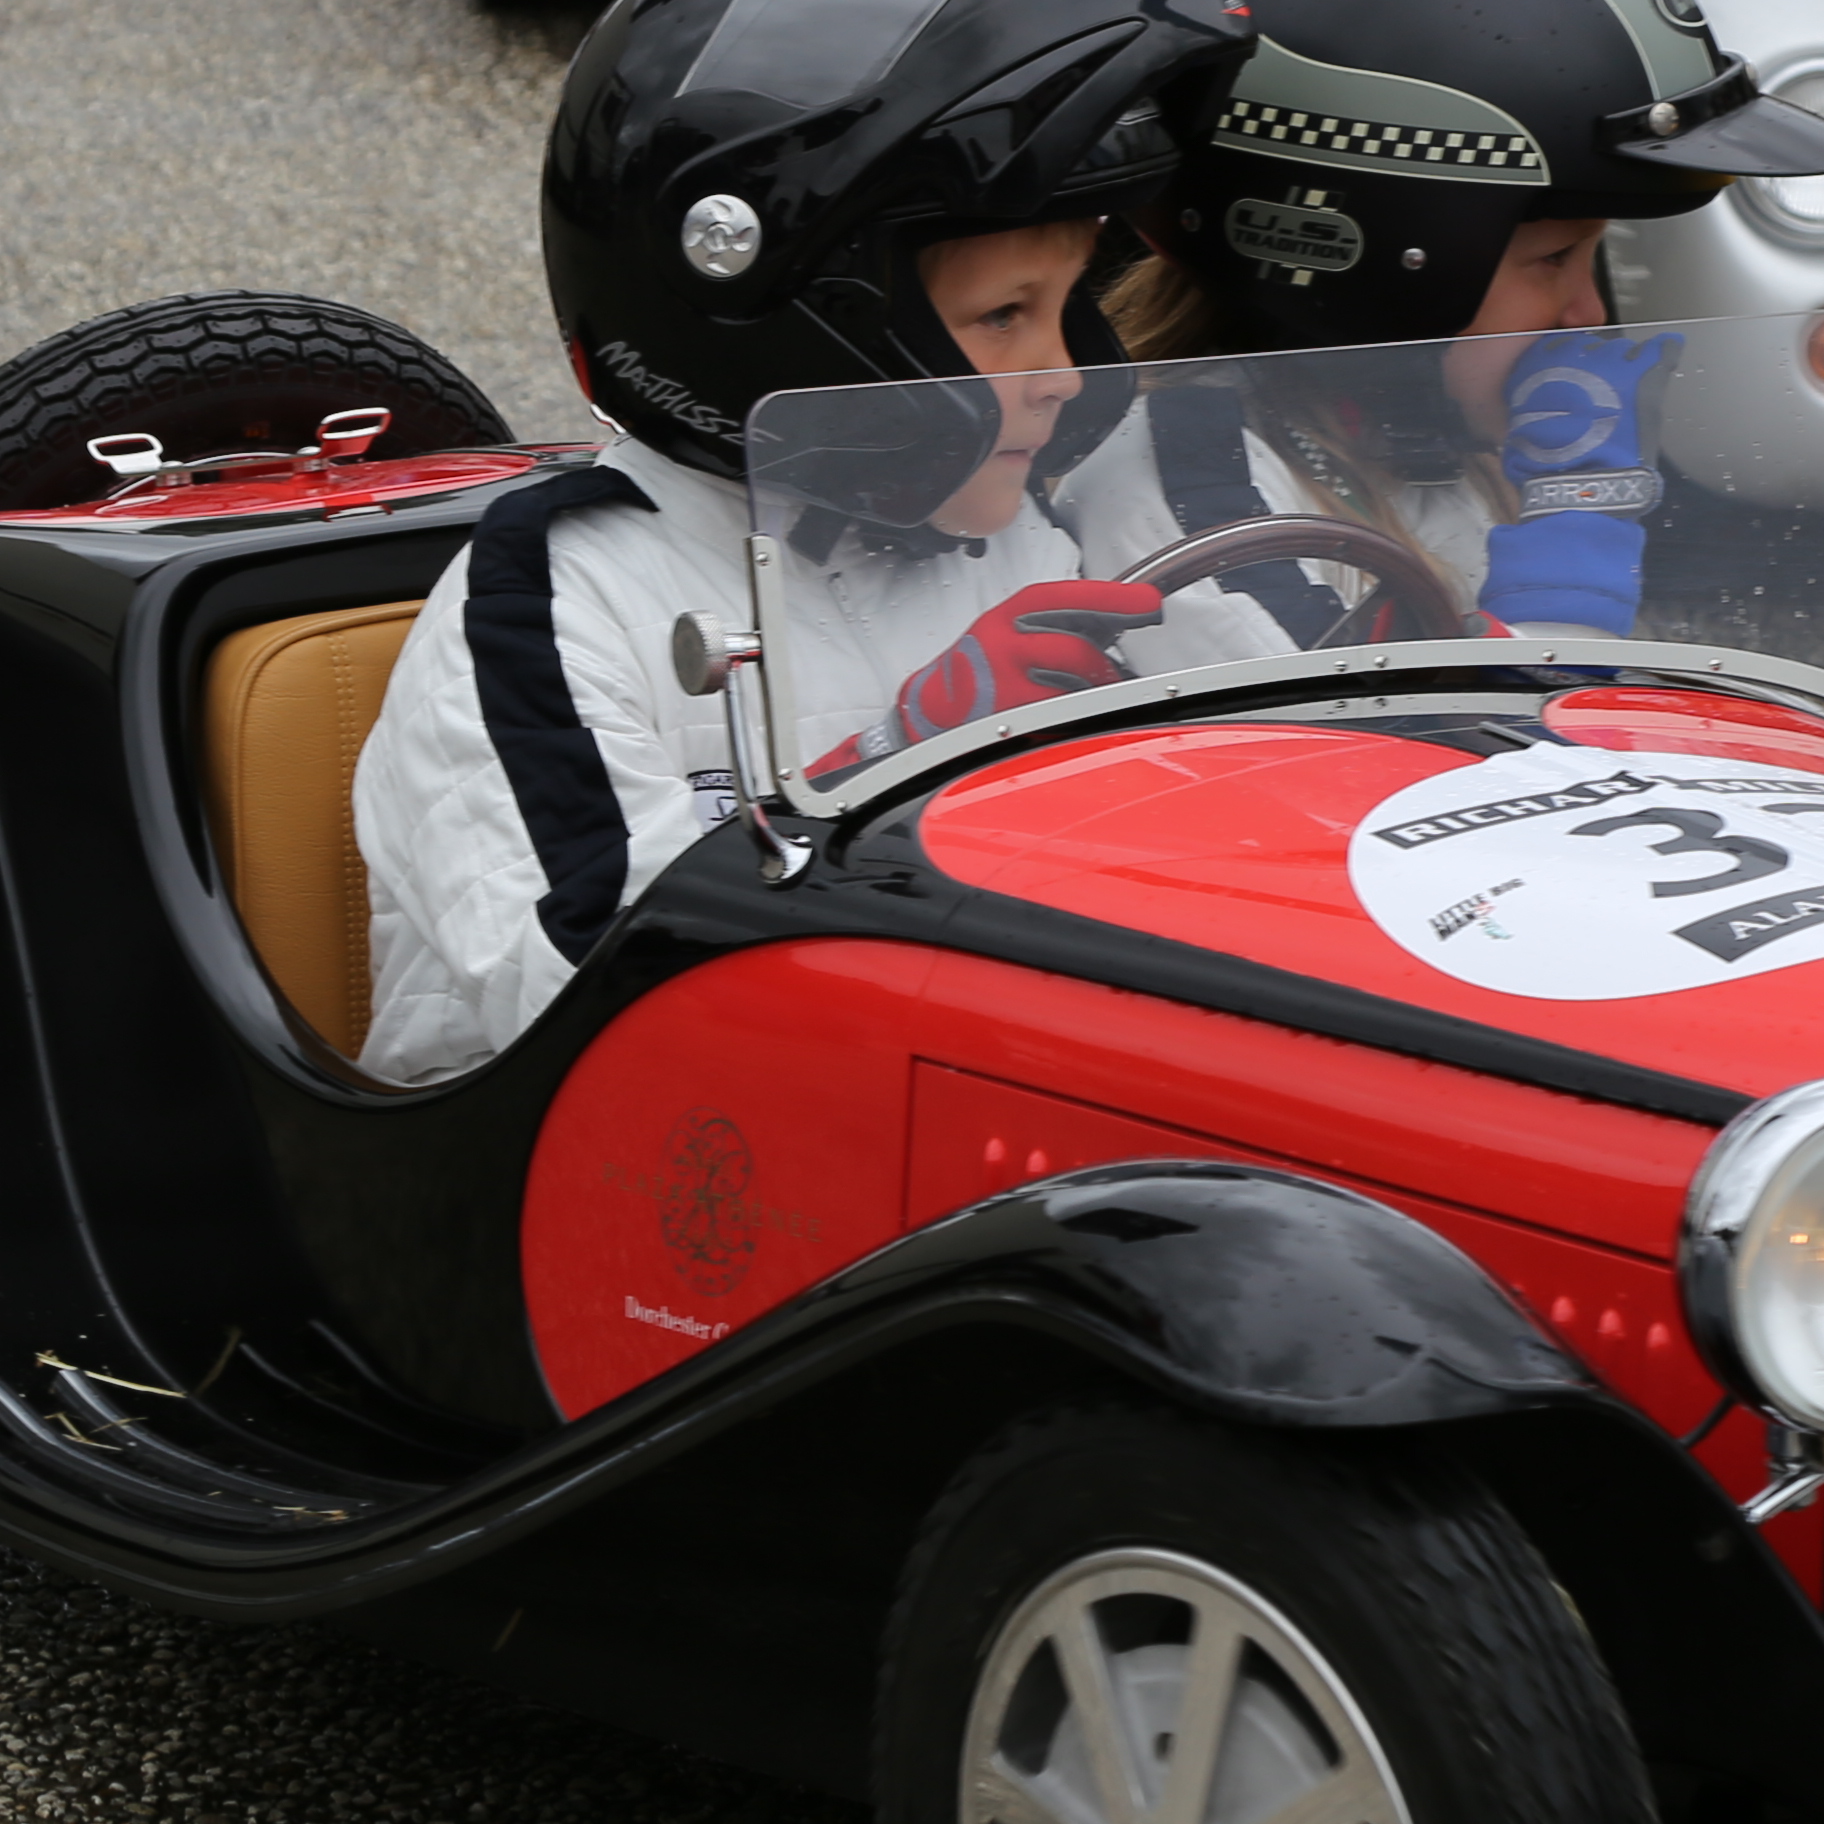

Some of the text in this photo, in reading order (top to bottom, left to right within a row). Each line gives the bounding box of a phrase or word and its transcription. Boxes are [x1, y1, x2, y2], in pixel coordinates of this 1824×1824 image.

[1236, 209, 1358, 244] U.S.
[1234, 229, 1353, 261] TRADITION
[1428, 892, 1488, 928] LITTLE
[601, 1161, 683, 1202] PLAZA
[625, 1295, 712, 1340] Dorchester
